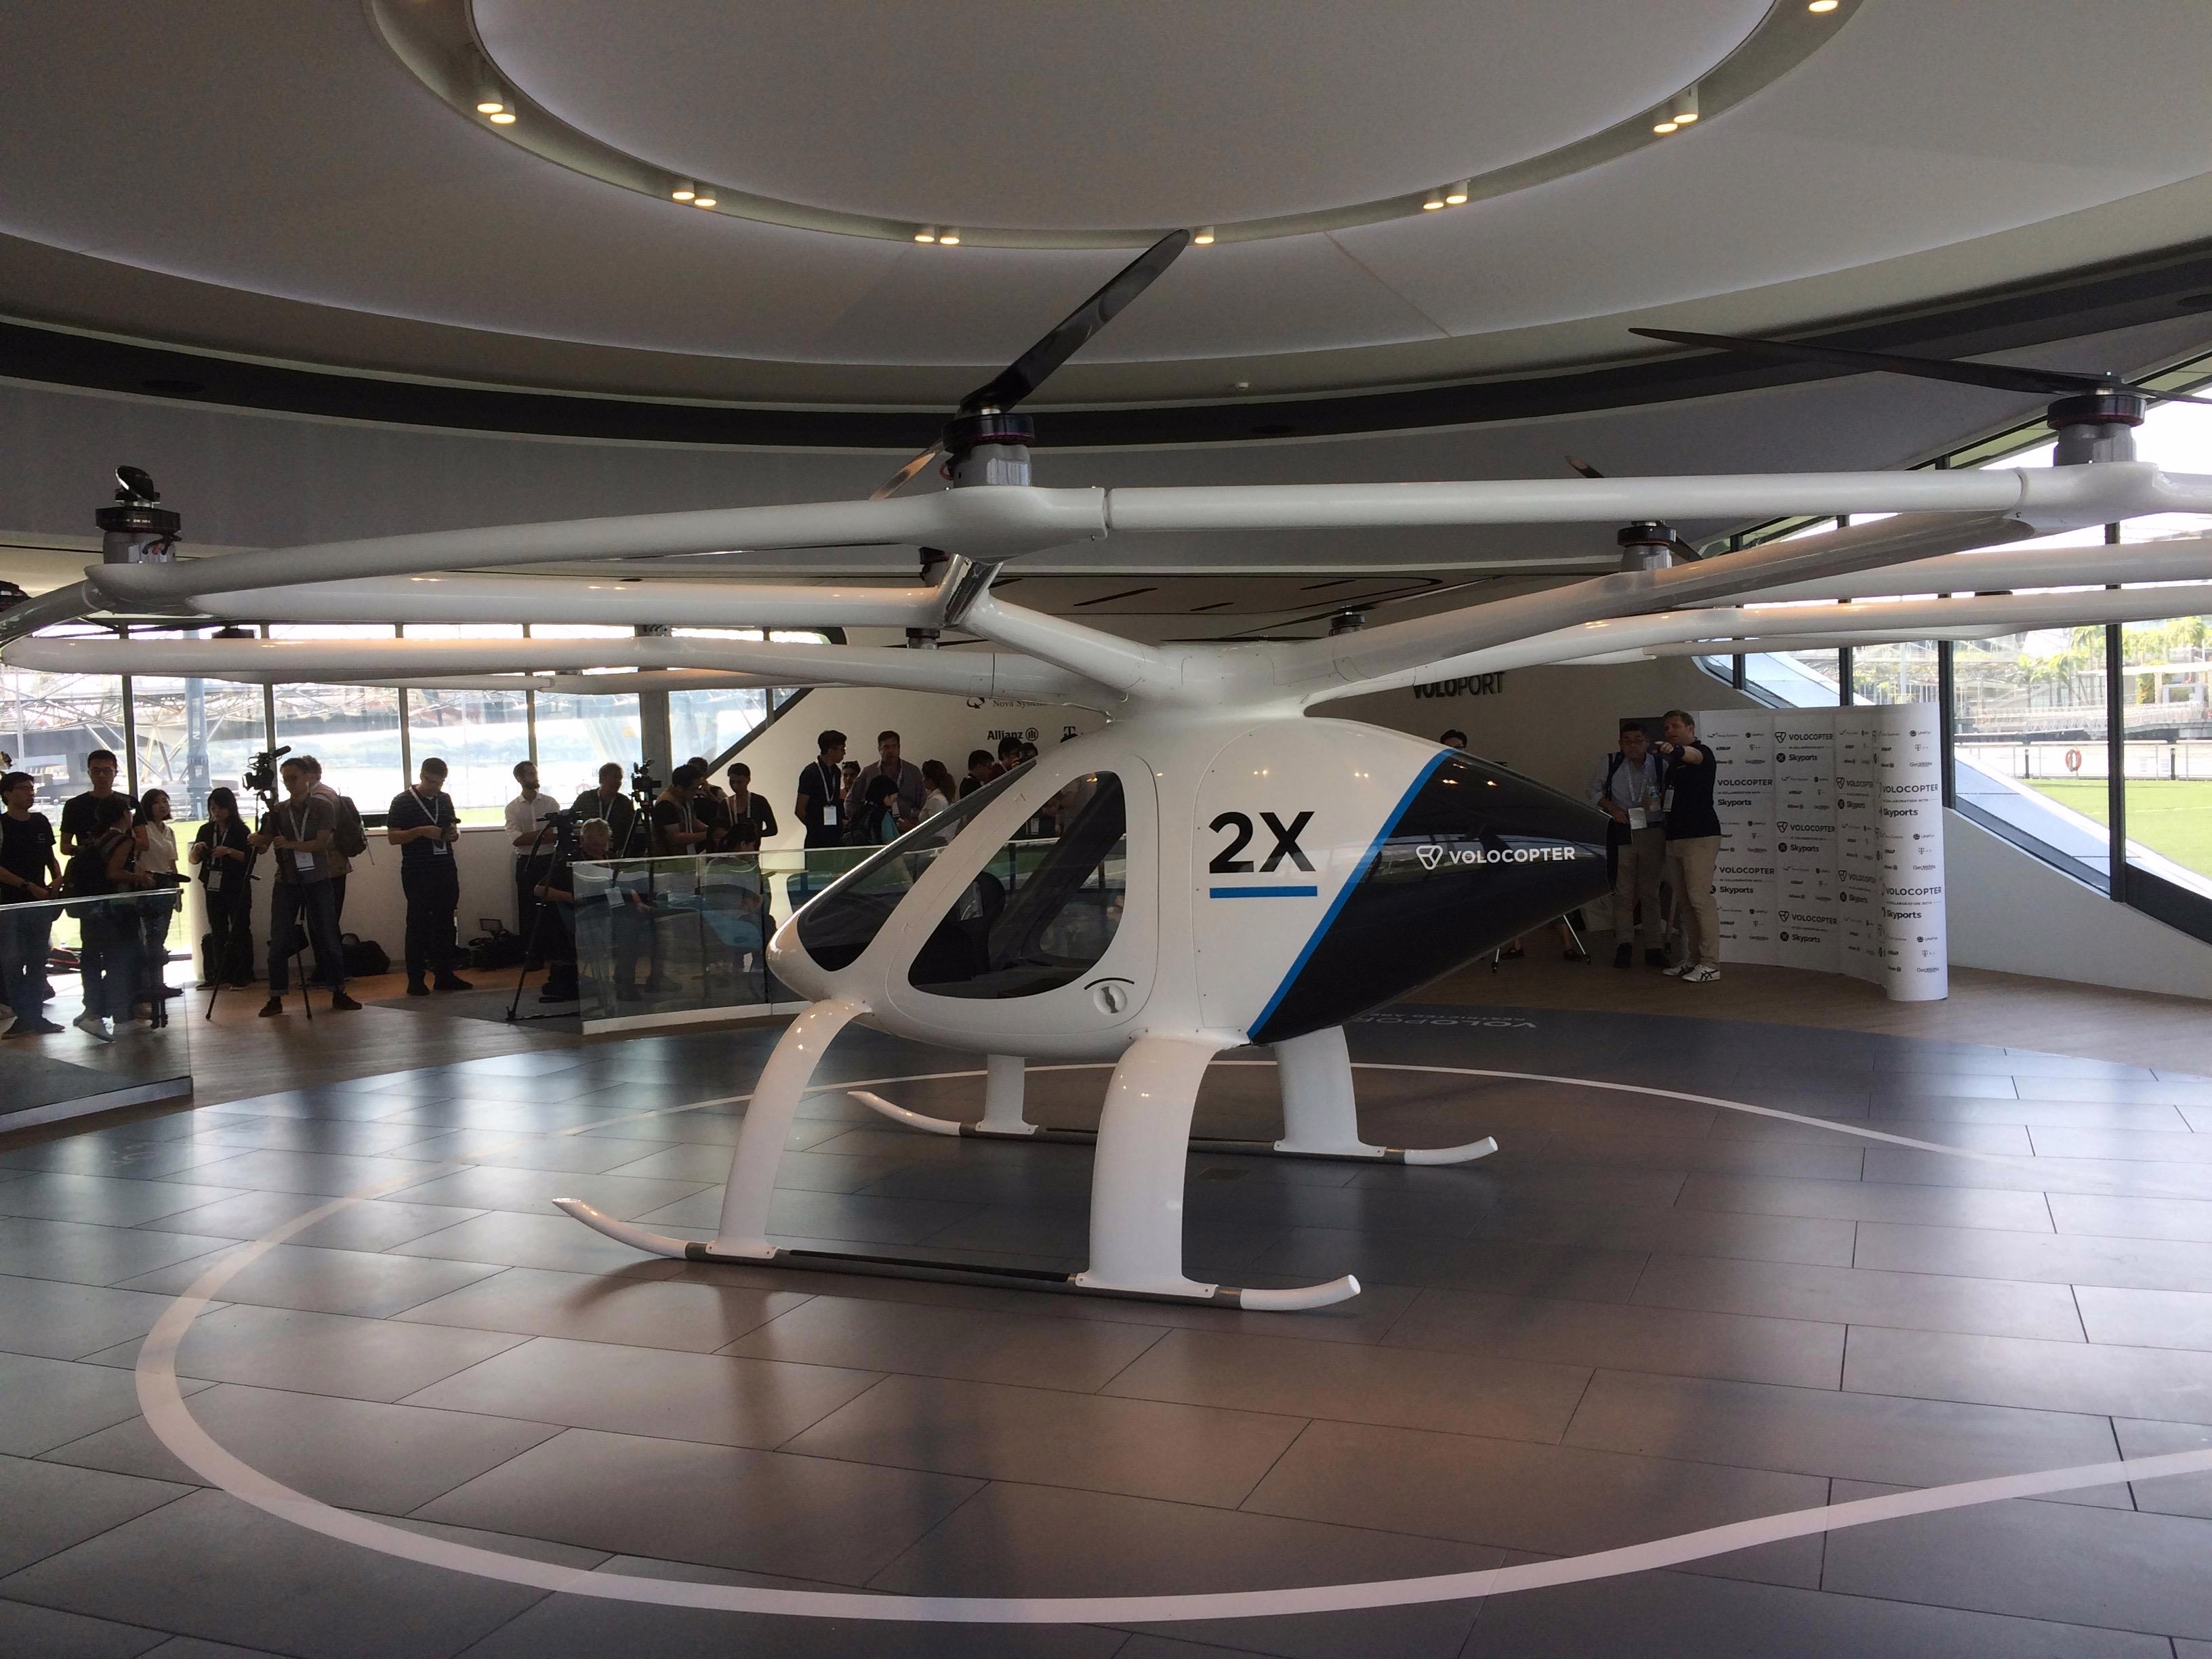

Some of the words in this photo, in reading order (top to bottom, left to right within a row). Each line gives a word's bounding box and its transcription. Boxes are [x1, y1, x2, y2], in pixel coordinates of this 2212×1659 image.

[987, 730, 1023, 740] Allianz
[1788, 754, 1818, 762] Skyports
[1883, 808, 1919, 817] Skyports
[1208, 811, 1315, 874] 2X
[1790, 844, 1820, 853] Skyports
[1448, 846, 1576, 865] VOLOCOPTER
[1719, 886, 1754, 895] Skyports
[1886, 886, 1942, 896] VOLOCOPTER
[1791, 914, 1837, 924] VOLOCOPTER
[1887, 910, 1922, 920] Skyports
[1792, 933, 1821, 943] Skyports
